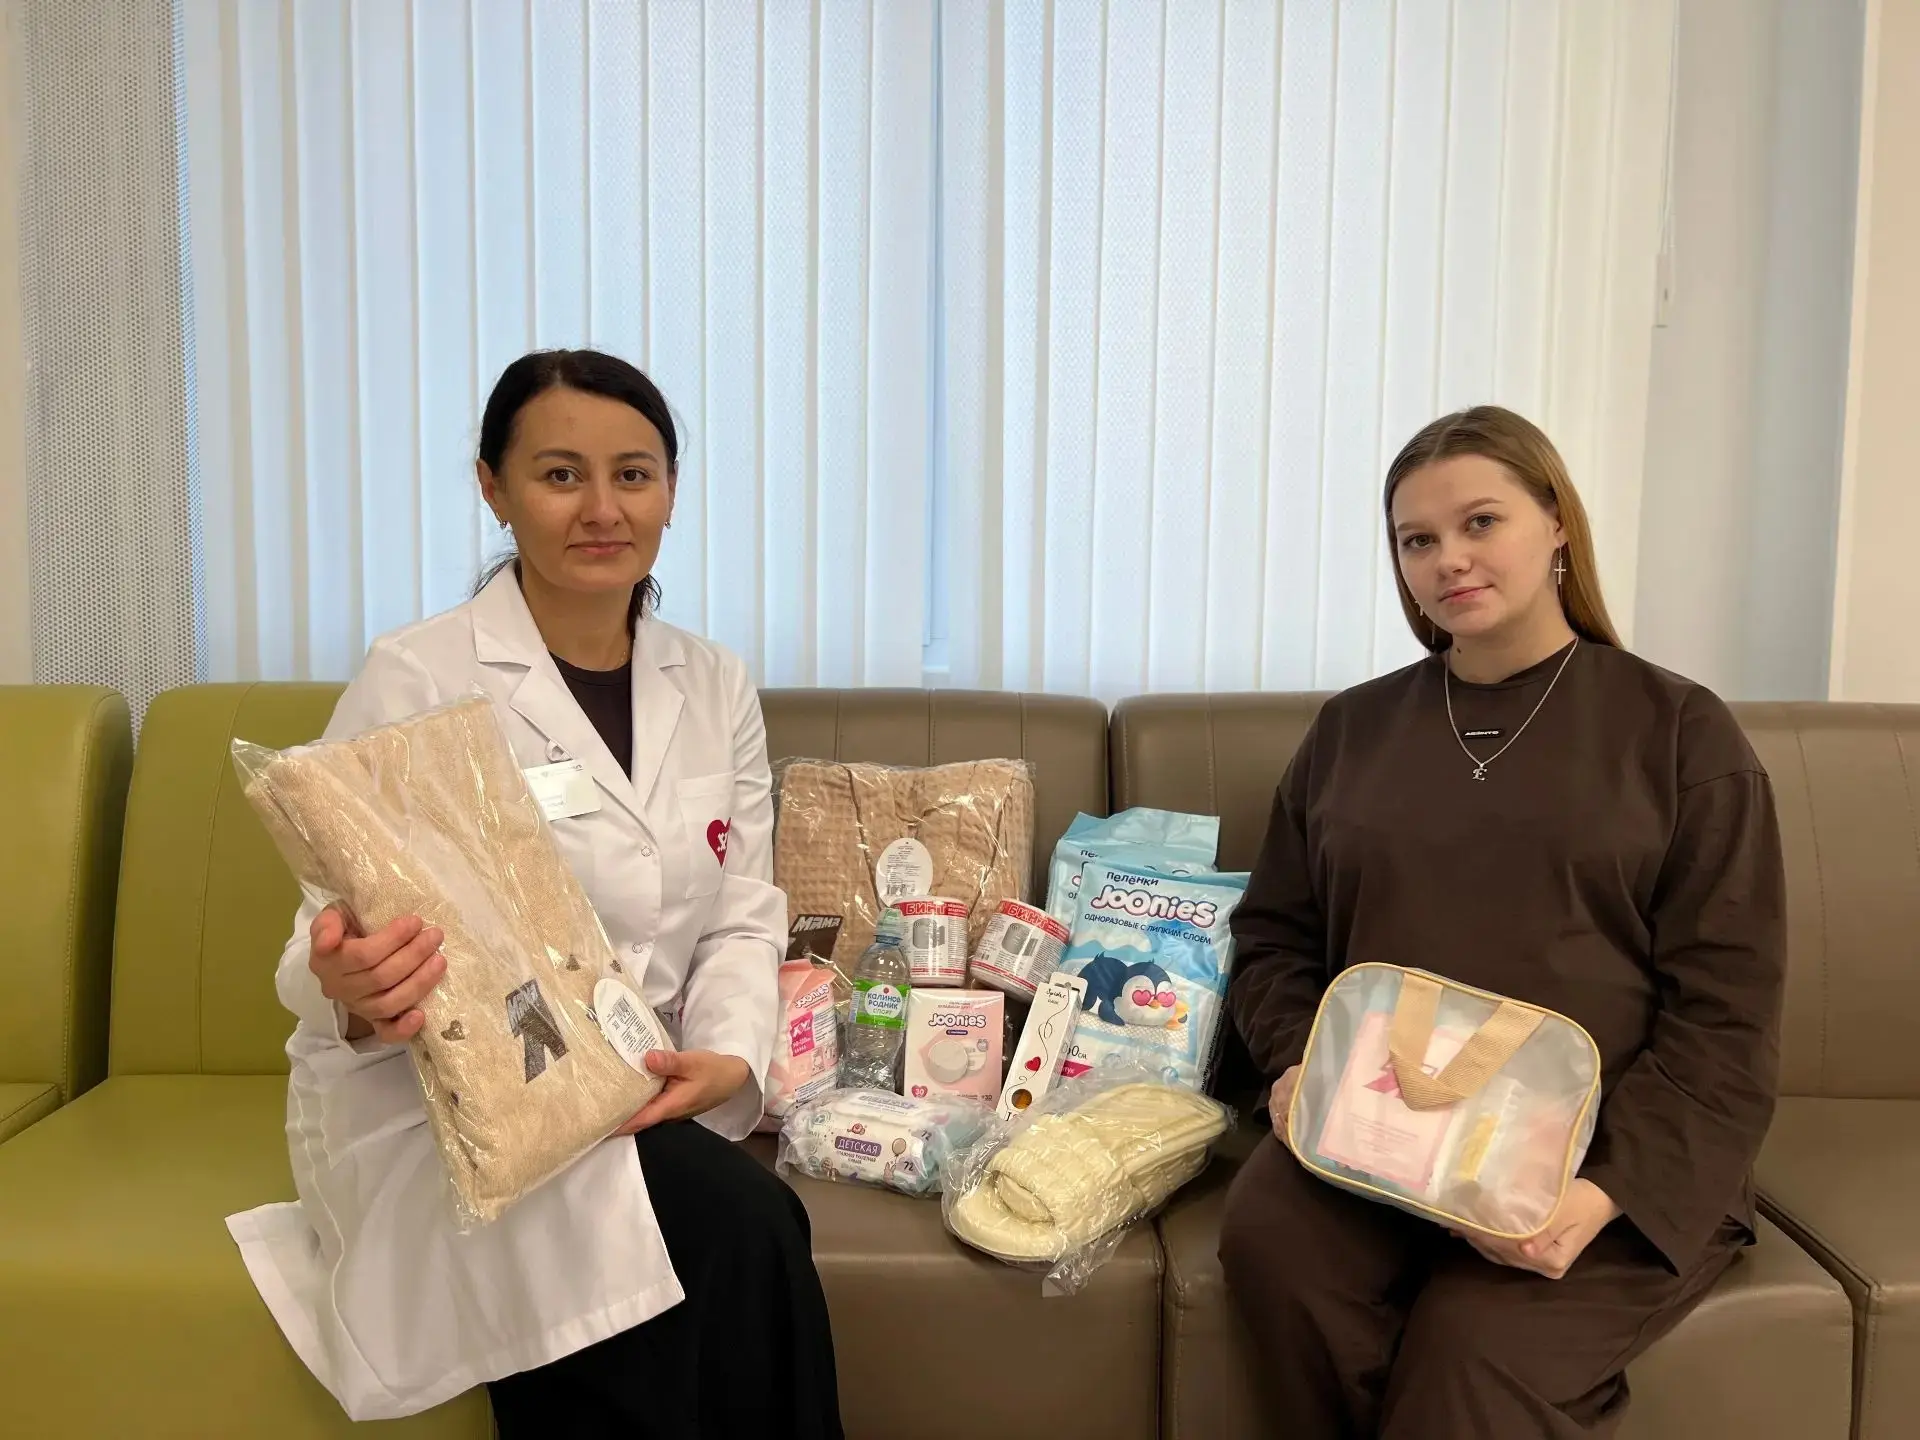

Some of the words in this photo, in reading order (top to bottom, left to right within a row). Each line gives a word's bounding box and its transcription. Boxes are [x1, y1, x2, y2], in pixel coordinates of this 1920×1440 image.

[1007, 904, 1049, 929] БИНТ
[1084, 913, 1139, 930] ОДНОРАЗОВЫЕ
[1147, 925, 1181, 938] ЛИПКИМ
[1183, 932, 1211, 945] СЛОЕМ
[914, 1088, 925, 1096] 30
[837, 1138, 878, 1155] ДЕТСКАЯ
[903, 1161, 914, 1171] 72
